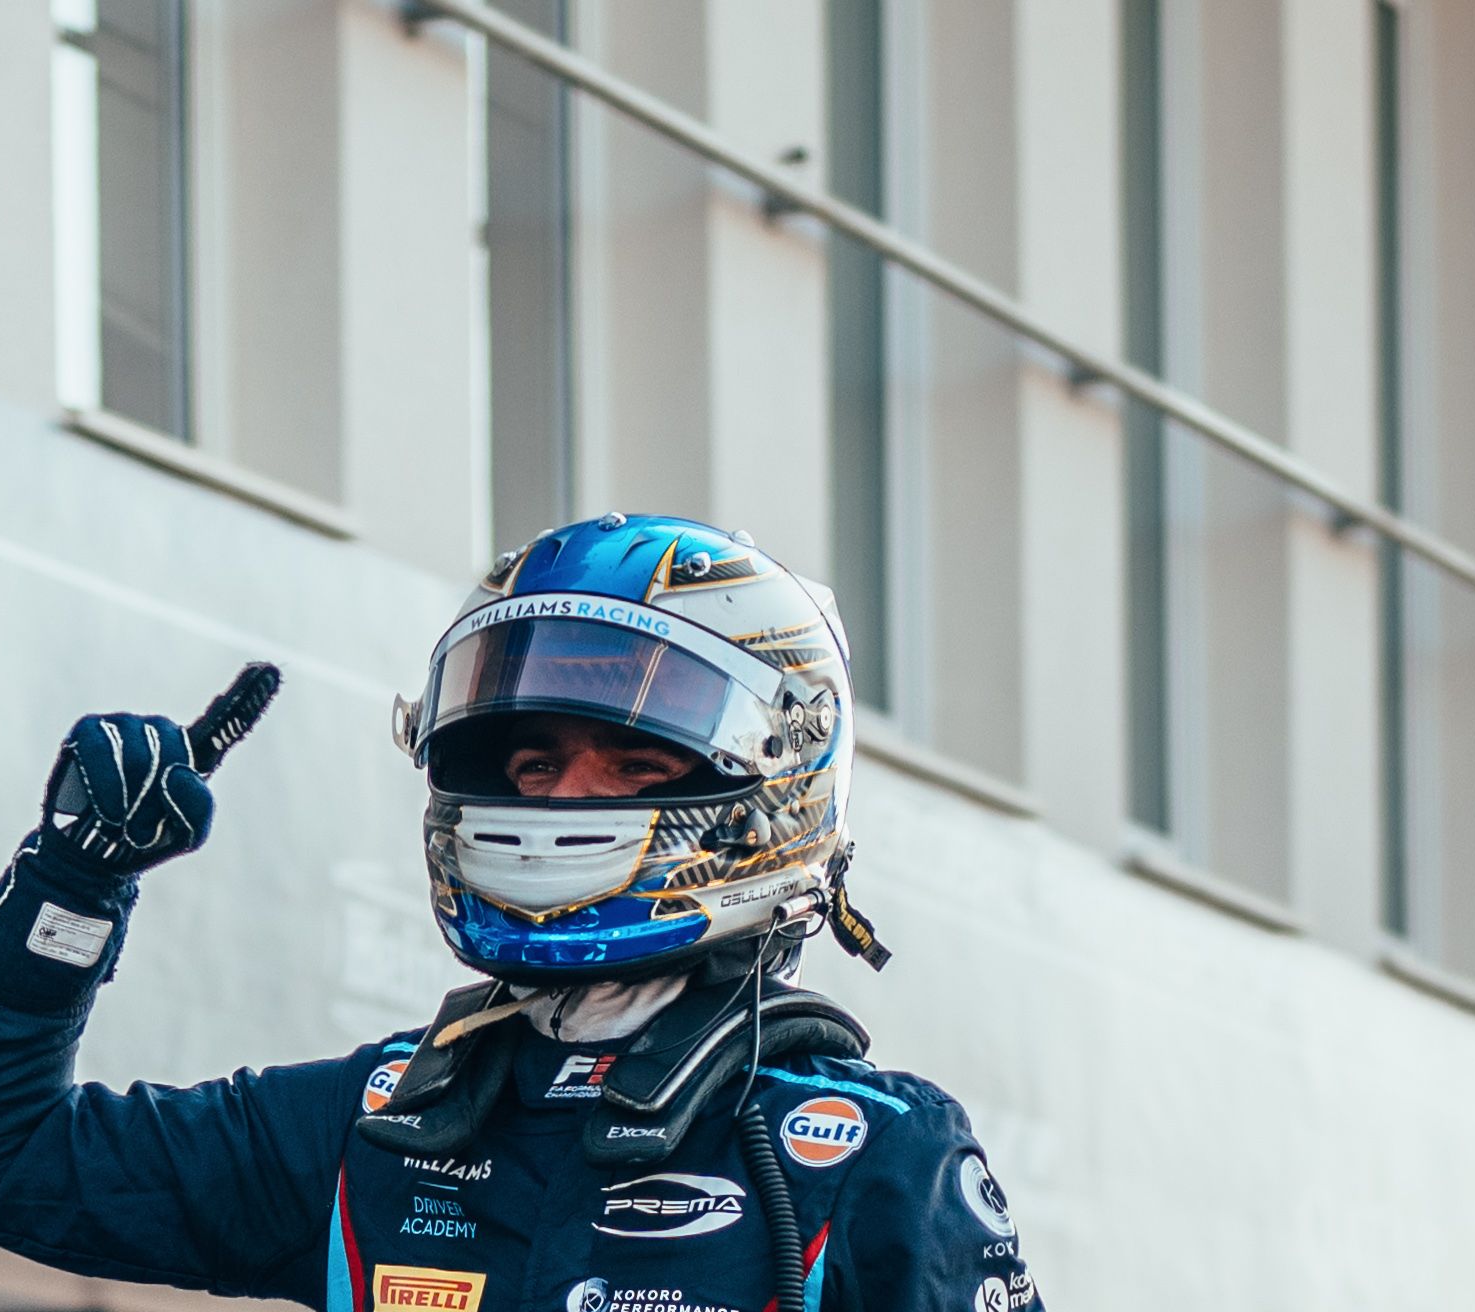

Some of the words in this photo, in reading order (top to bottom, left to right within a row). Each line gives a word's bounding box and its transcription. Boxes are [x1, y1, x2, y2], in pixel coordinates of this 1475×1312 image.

[470, 599, 573, 630] WILLIAMS
[576, 603, 672, 636] RACING
[787, 1111, 861, 1148] Gulf
[604, 1193, 743, 1216] PREMA
[400, 1218, 477, 1239] ACADEMY
[379, 1274, 473, 1311] PIRELLI
[613, 1289, 683, 1302] KOKORO
